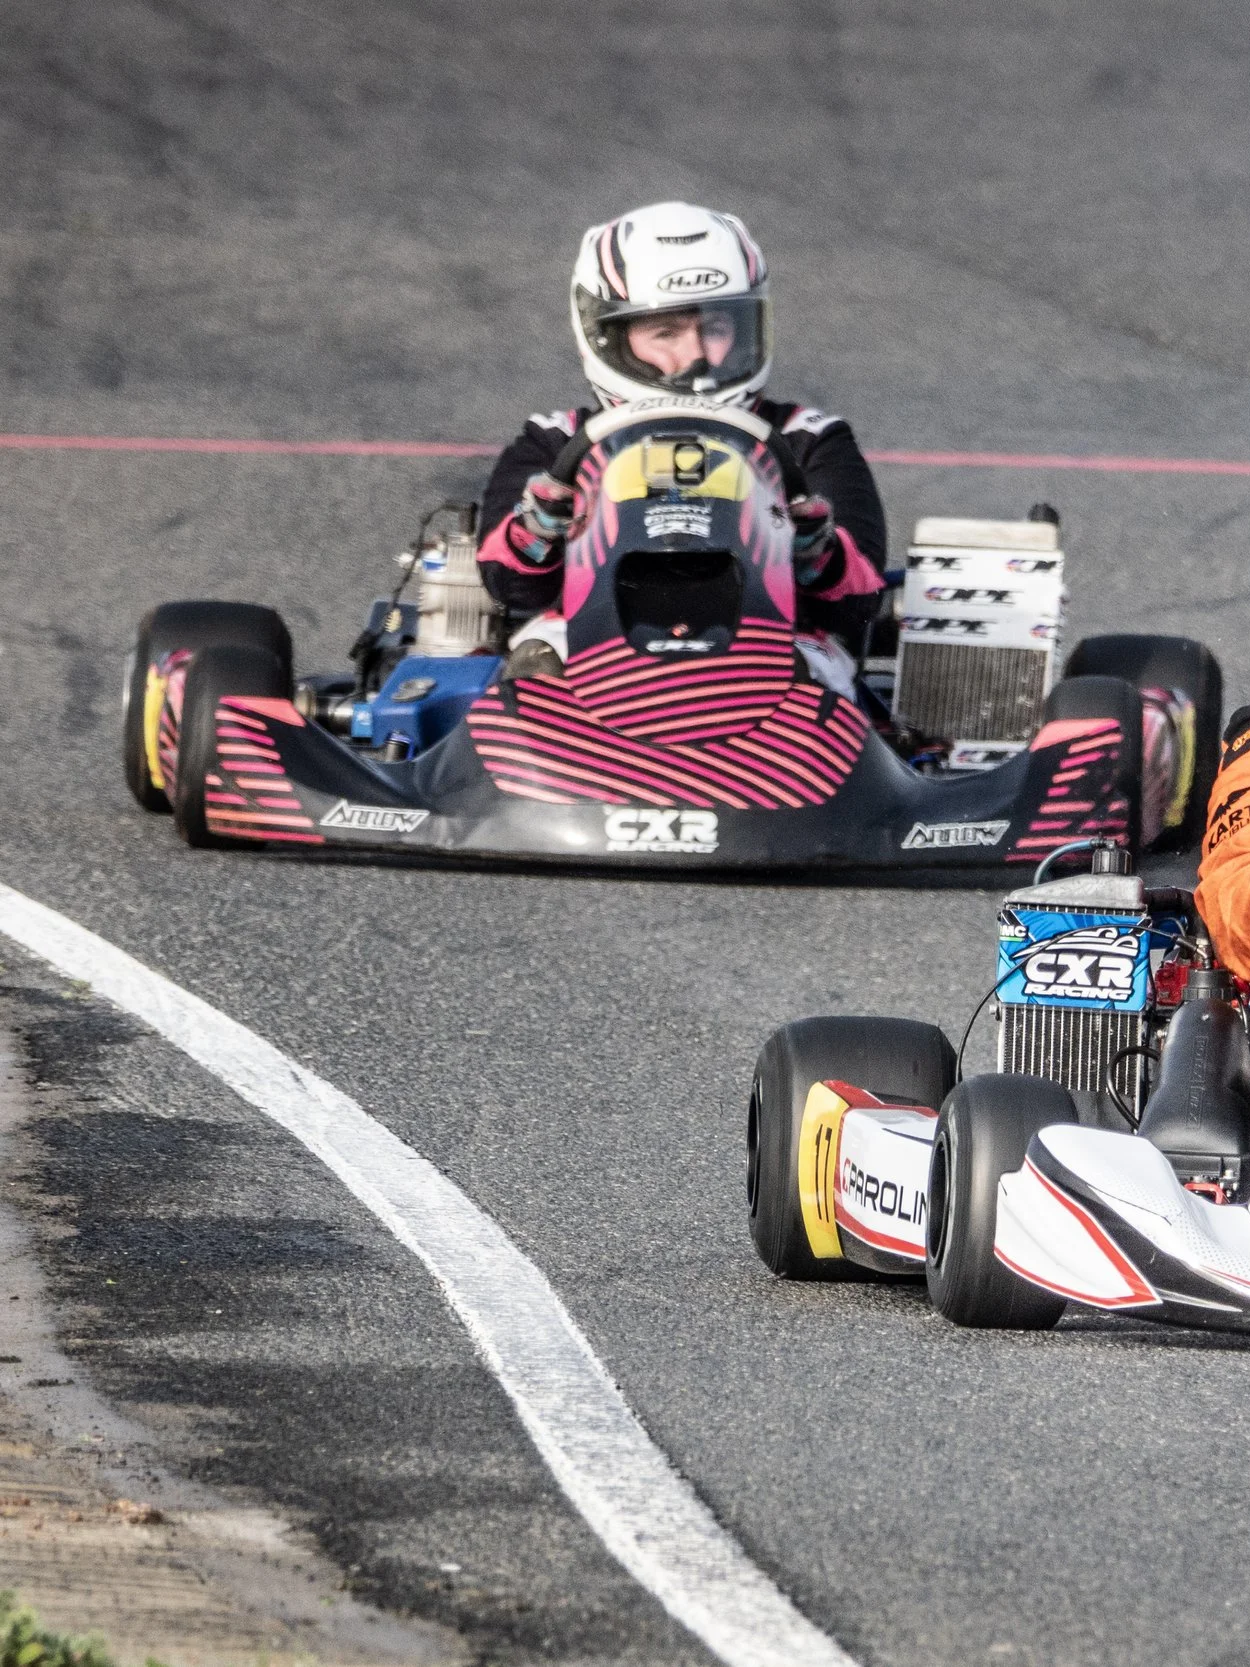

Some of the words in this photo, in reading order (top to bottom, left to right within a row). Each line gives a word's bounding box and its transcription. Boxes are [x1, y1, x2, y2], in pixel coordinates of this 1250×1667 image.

[667, 271, 719, 290] HJC
[605, 809, 719, 843] CXR
[1000, 925, 1027, 938] MC
[1025, 953, 1134, 988] CXR
[1024, 984, 1134, 1001] RACING
[848, 1162, 927, 1225] PAROLIN
